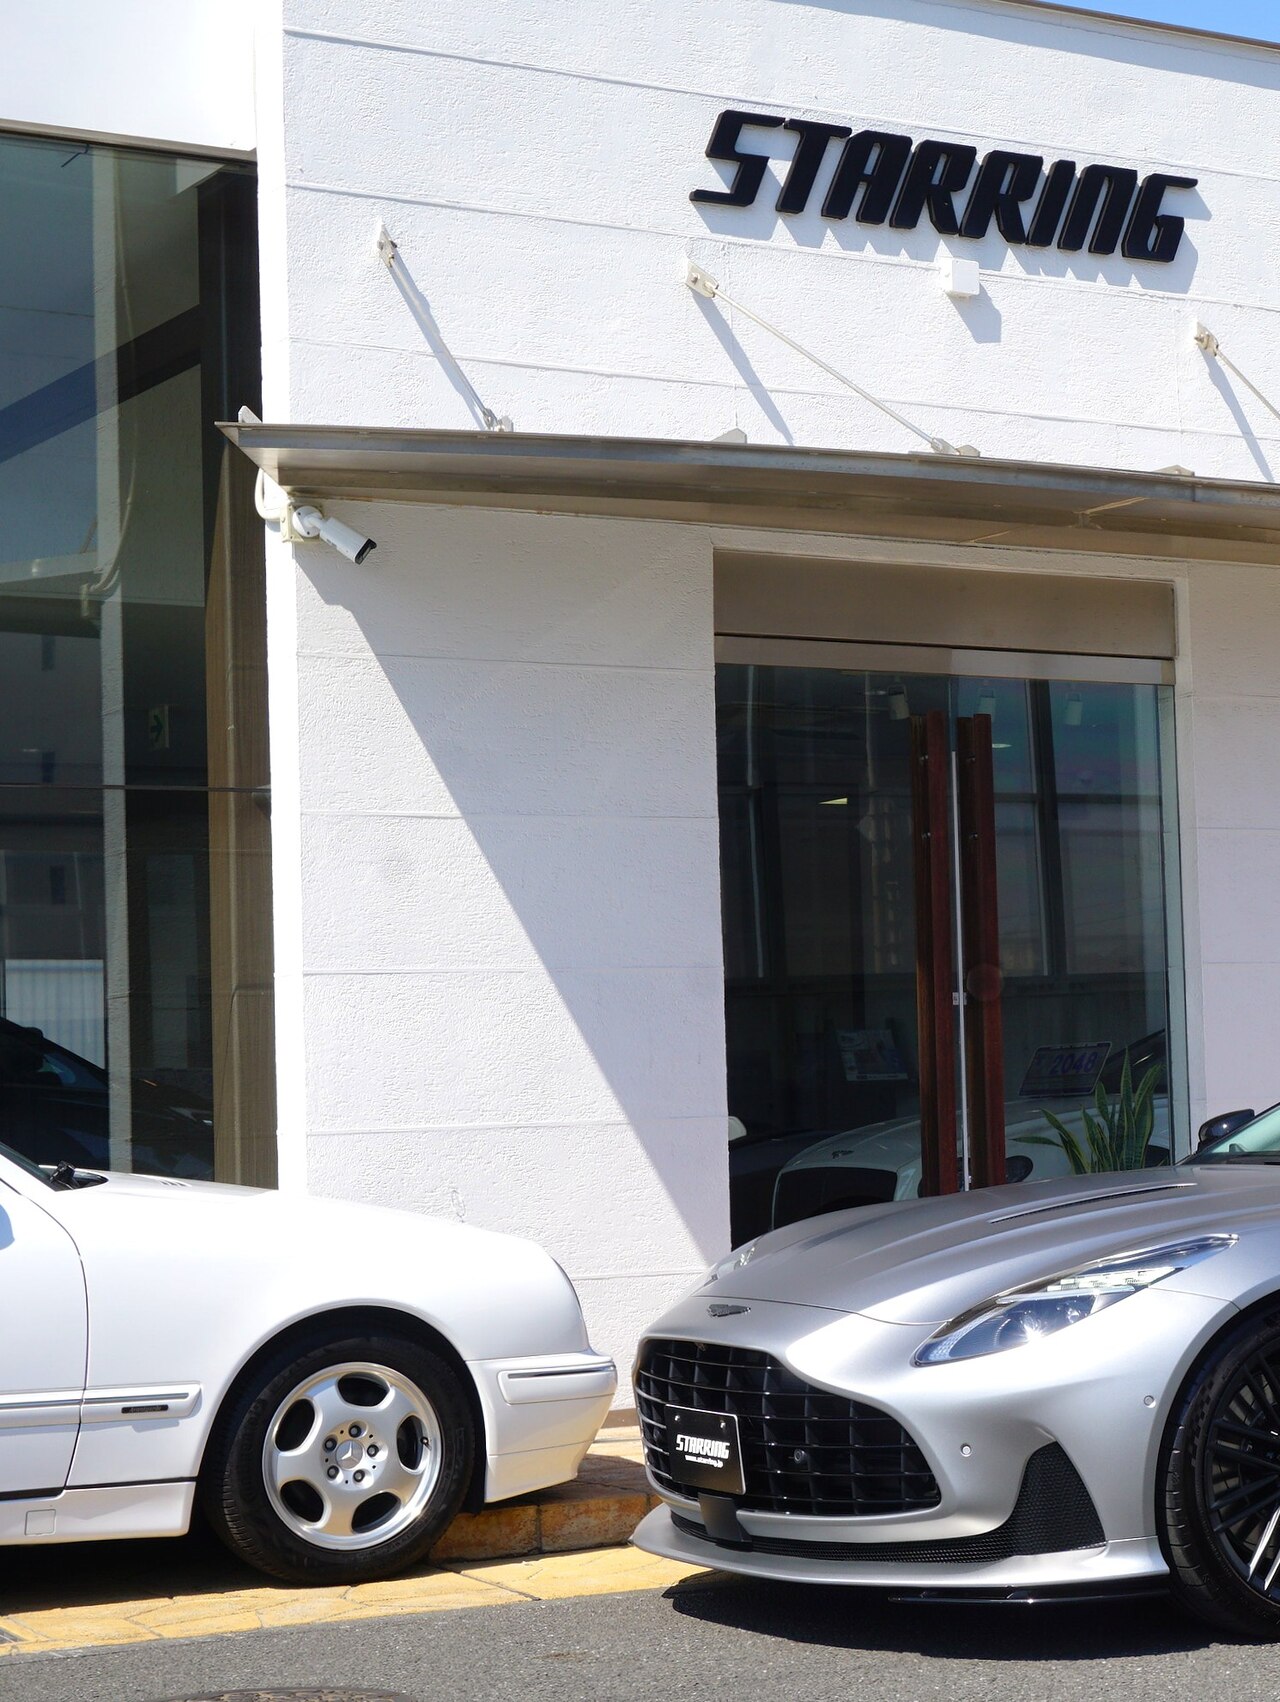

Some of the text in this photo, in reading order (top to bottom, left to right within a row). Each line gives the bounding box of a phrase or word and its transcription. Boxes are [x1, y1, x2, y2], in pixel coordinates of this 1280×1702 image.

[689, 109, 1198, 263] STARRING
[1049, 1052, 1098, 1075] 2048
[675, 1434, 730, 1459] STARRING
